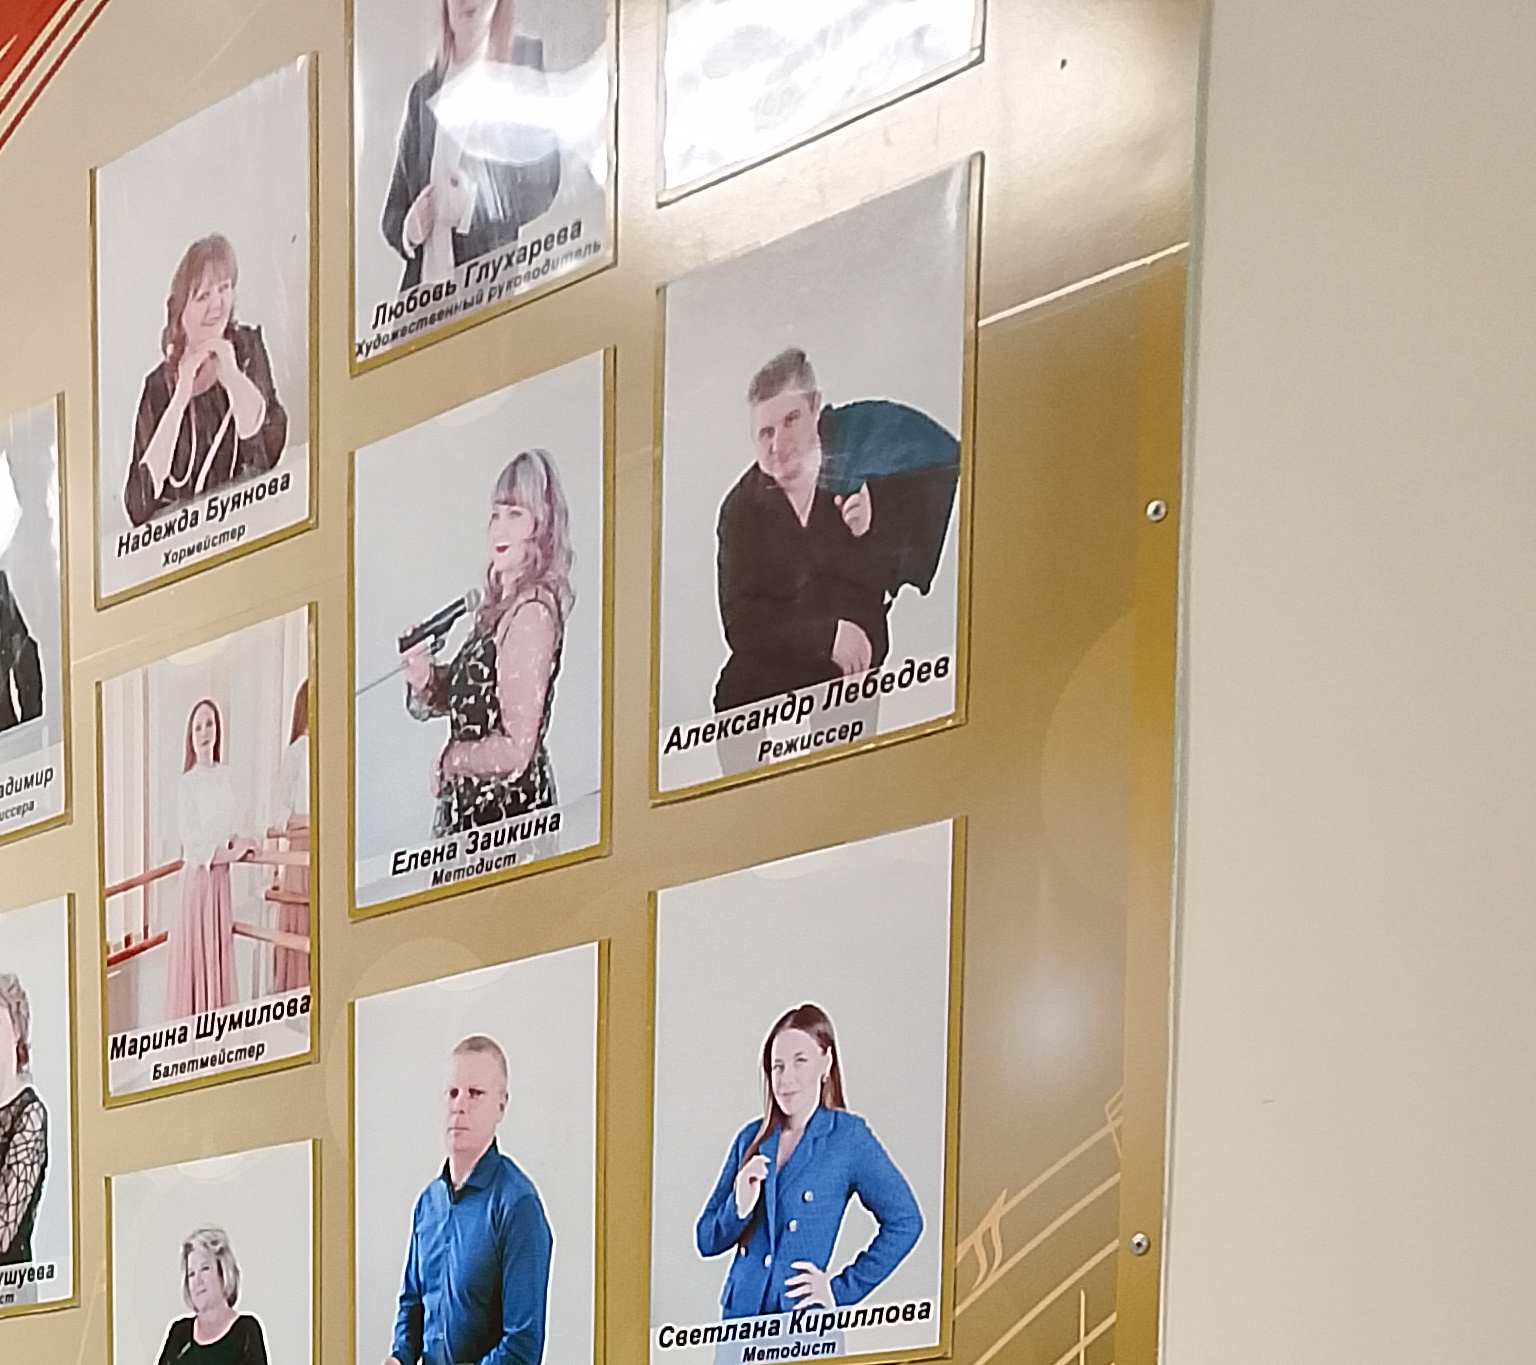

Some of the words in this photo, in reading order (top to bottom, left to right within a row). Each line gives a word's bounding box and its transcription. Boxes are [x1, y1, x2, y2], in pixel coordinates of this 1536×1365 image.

[355, 289, 483, 356] Художественный
[488, 241, 601, 302] руководитель
[372, 279, 456, 330] Любовь
[464, 220, 582, 288] Глухарева
[117, 509, 199, 557] Надежда
[206, 473, 290, 522] Буянова
[163, 524, 245, 567] Хормейстер
[664, 692, 813, 754] Александр
[822, 656, 950, 710] Лебедев
[758, 720, 863, 761] Режиссер
[392, 842, 457, 875] Елена
[466, 813, 560, 854] Заикина
[431, 853, 516, 886] Методист
[110, 1025, 187, 1060] Марина
[195, 994, 310, 1041] Шумилова
[153, 1043, 265, 1080] Балетмейстер
[659, 1318, 780, 1348] Светлана
[789, 1301, 931, 1337] Кириллова
[743, 1341, 836, 1363] Методист
